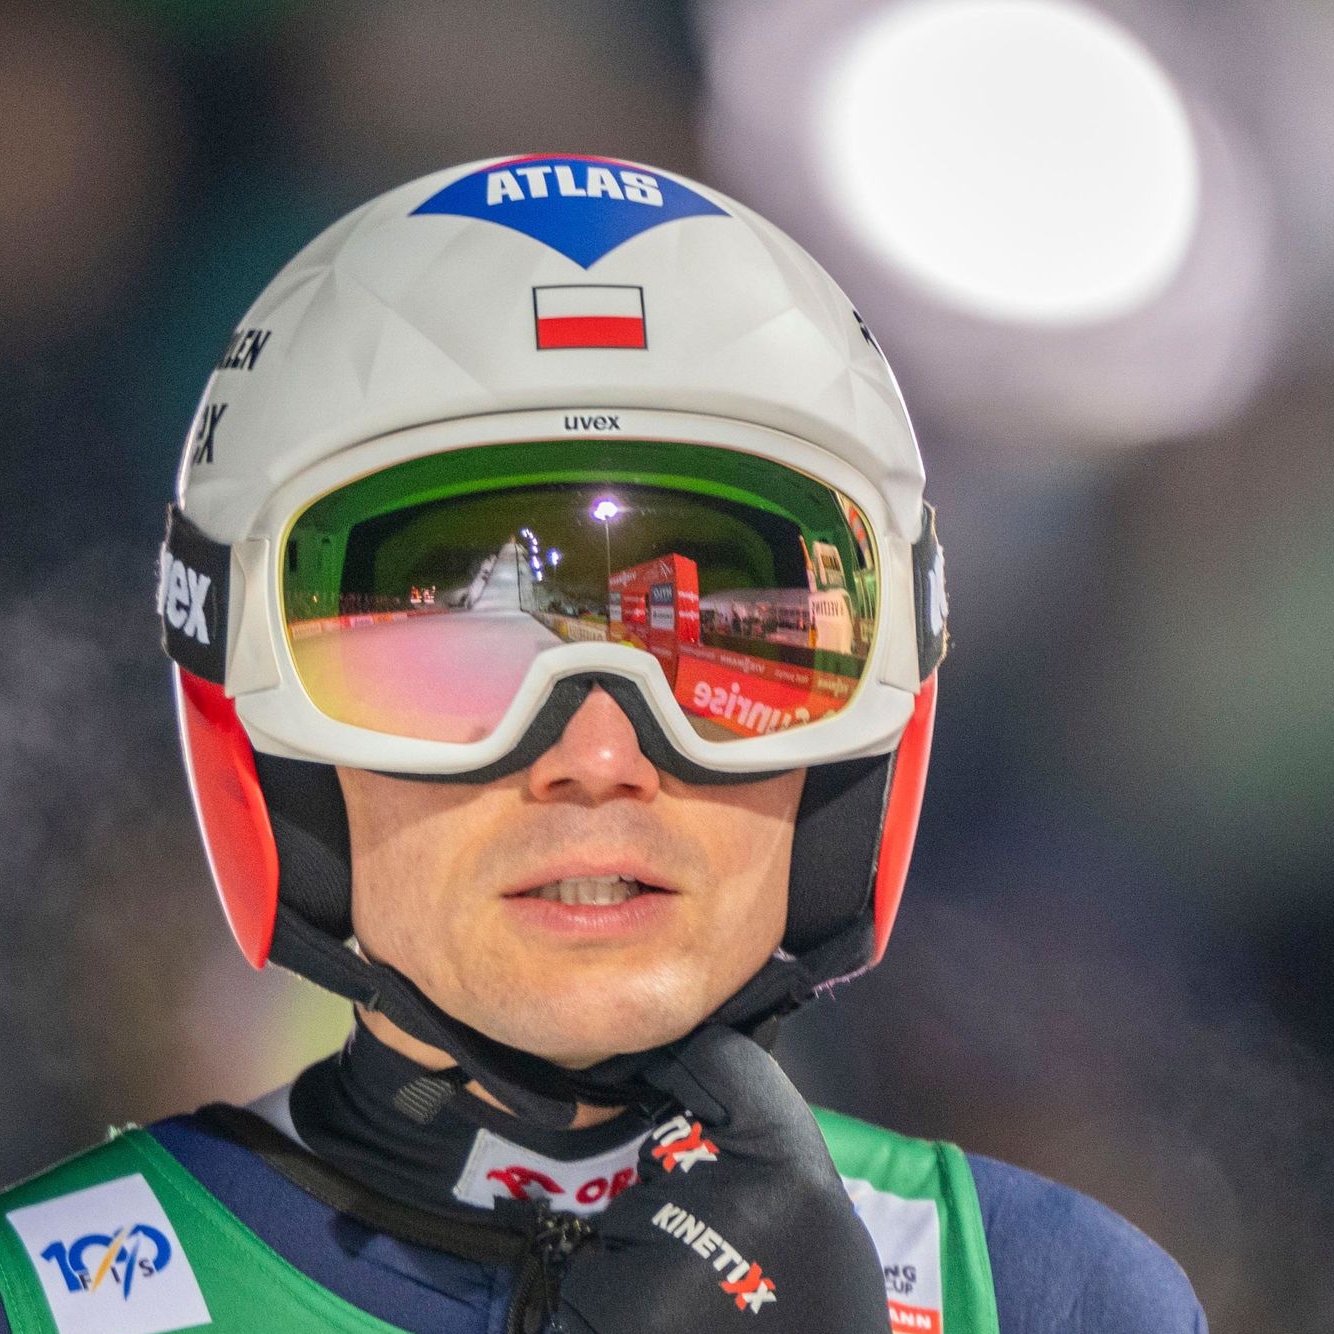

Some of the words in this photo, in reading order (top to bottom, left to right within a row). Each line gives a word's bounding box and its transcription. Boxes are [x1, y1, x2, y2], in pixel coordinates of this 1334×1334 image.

[487, 165, 663, 207] ATLAS
[564, 415, 621, 431] uvex
[158, 552, 212, 646] ex
[652, 1202, 777, 1315] KINETIXX
